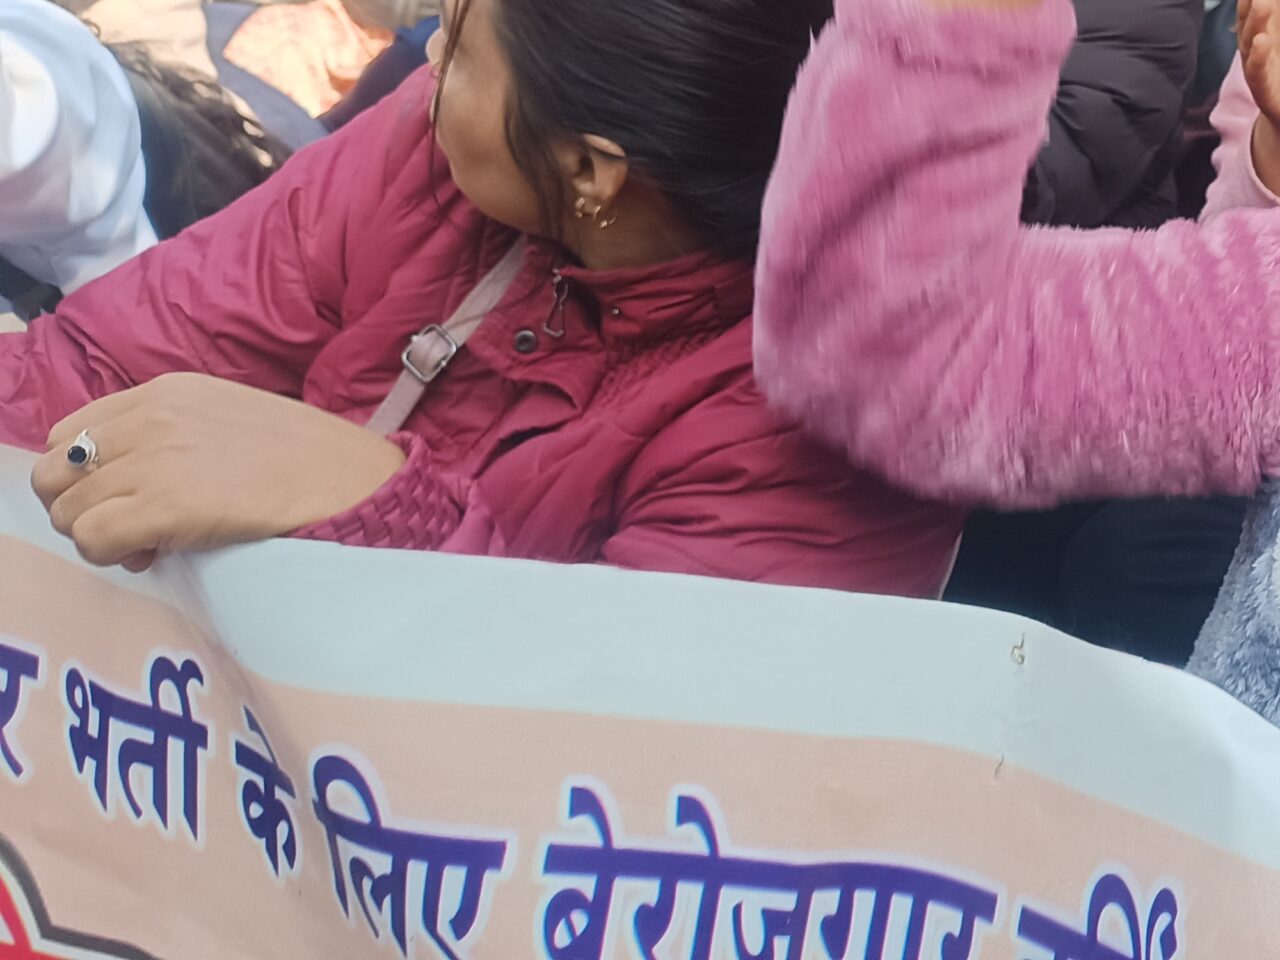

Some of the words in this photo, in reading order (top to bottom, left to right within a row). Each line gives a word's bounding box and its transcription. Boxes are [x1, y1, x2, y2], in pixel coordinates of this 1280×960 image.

[66, 656, 208, 842] भर्ती
[234, 705, 297, 877] के
[312, 755, 508, 960] लिए
